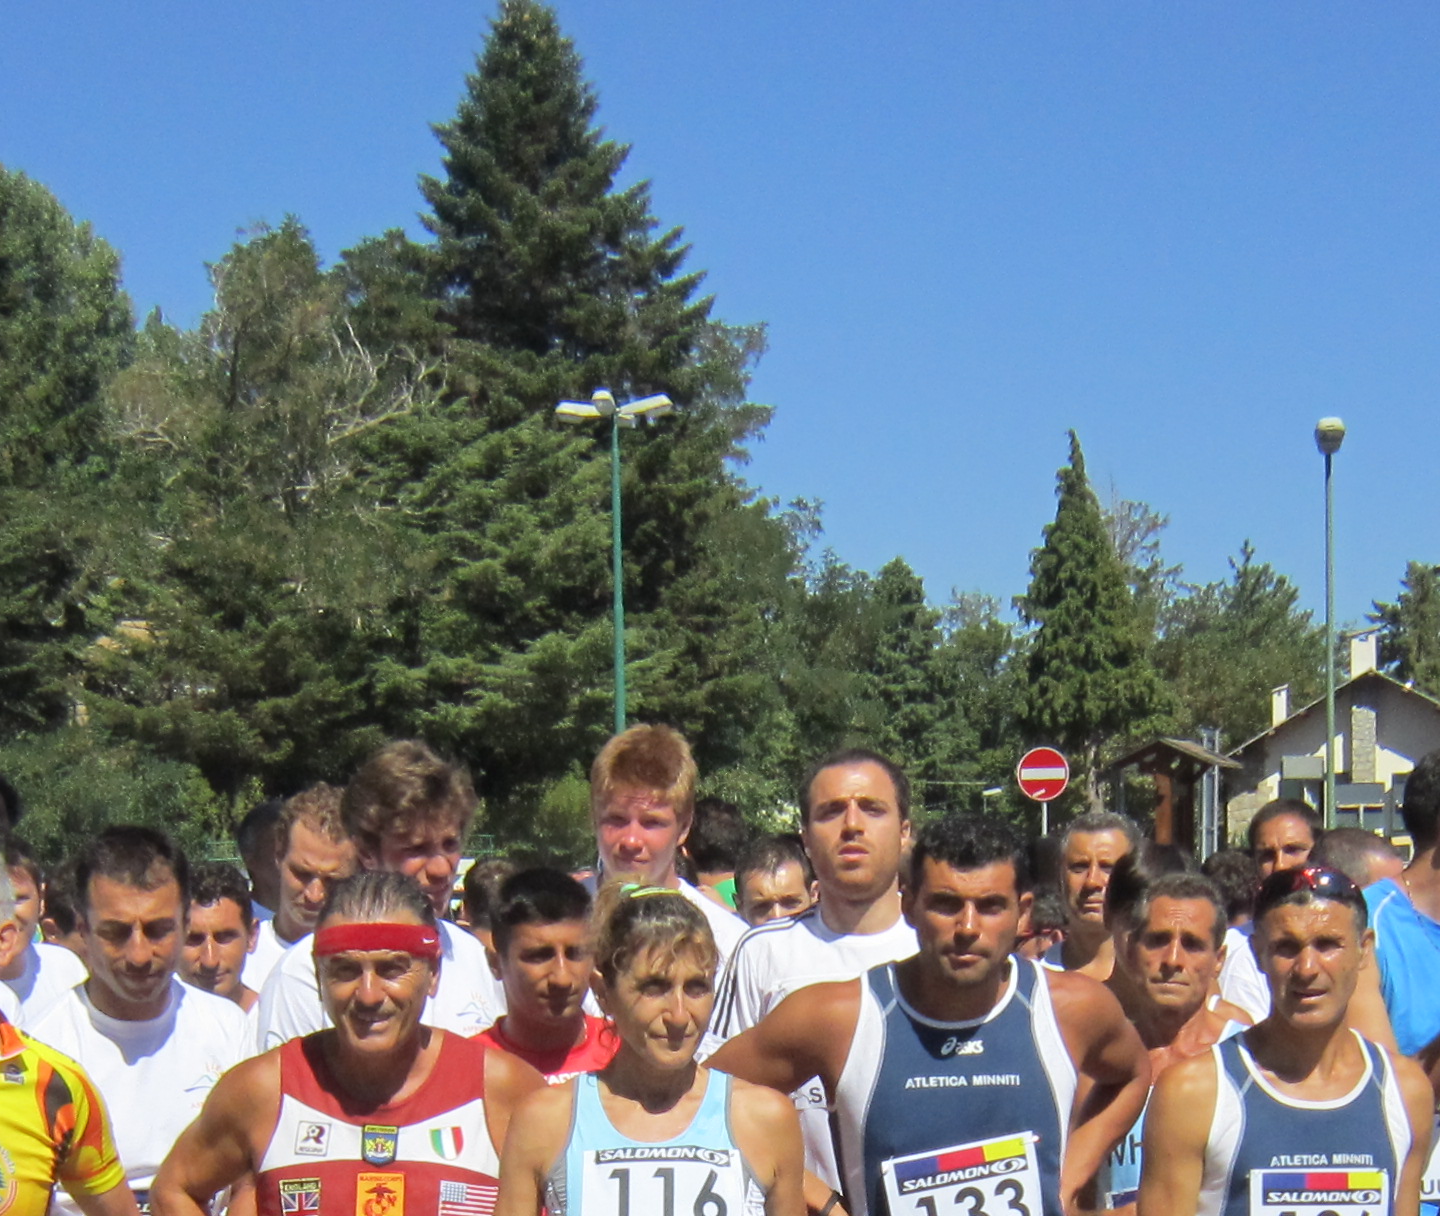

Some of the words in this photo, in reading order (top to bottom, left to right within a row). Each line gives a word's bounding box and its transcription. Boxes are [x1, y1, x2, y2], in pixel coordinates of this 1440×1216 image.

[905, 1076, 968, 1089] ATLETICA
[972, 1074, 1021, 1086] MINNITI
[600, 1147, 696, 1161] SALOMON
[1270, 1155, 1329, 1167] ATLETICA
[1332, 1153, 1374, 1166] MINNITI
[902, 1164, 990, 1192] SALOMON
[1266, 1191, 1351, 1203] SALOMON
